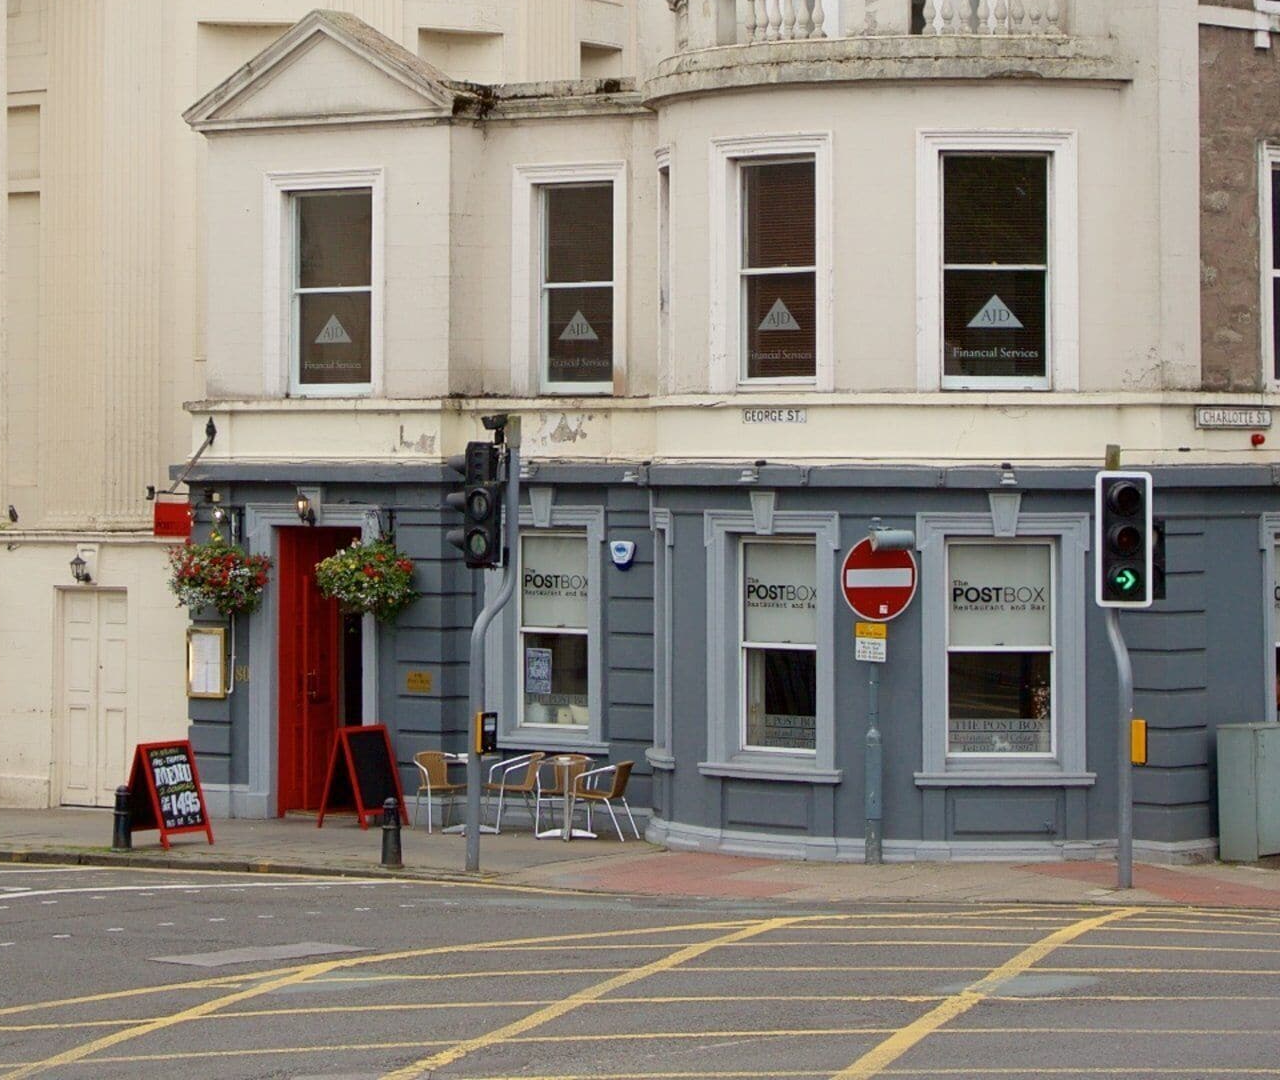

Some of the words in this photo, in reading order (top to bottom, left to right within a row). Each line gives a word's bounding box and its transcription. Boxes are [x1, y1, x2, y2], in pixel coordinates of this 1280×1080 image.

[768, 311, 791, 327] AJD
[982, 309, 1010, 324] AJD
[952, 347, 997, 358] Financial
[1000, 347, 1039, 358] Services
[745, 410, 783, 422] GEORGE
[747, 584, 816, 600] POSTBOX
[953, 586, 1045, 602] POSTBOX
[154, 763, 192, 787] MENU
